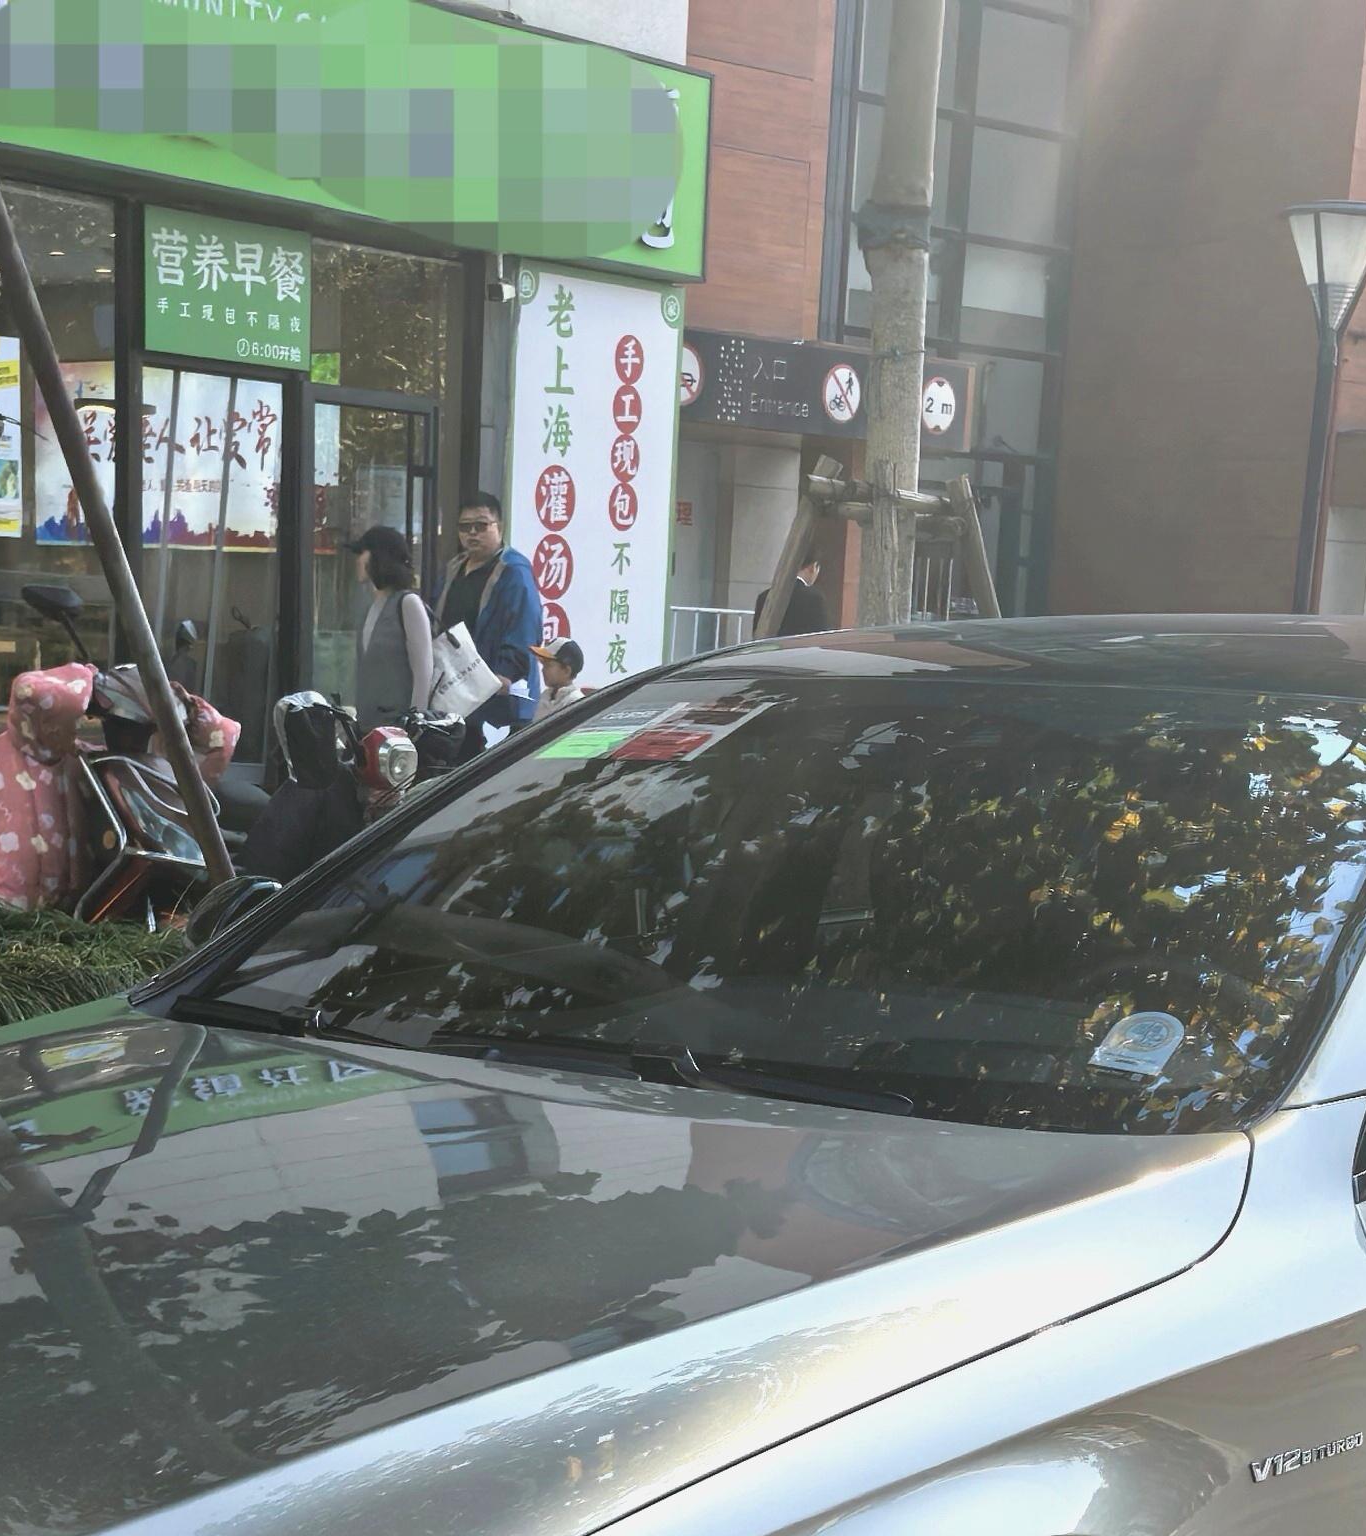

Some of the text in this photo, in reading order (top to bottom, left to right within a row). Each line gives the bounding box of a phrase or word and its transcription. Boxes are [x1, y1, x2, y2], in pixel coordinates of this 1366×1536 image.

[151, 227, 305, 303] 营养早餐
[156, 296, 301, 334] 手工现包不隔夜
[752, 356, 787, 380] 入口
[606, 338, 641, 675] 手工现包不隔夜
[1250, 1448, 1302, 1483] V12
